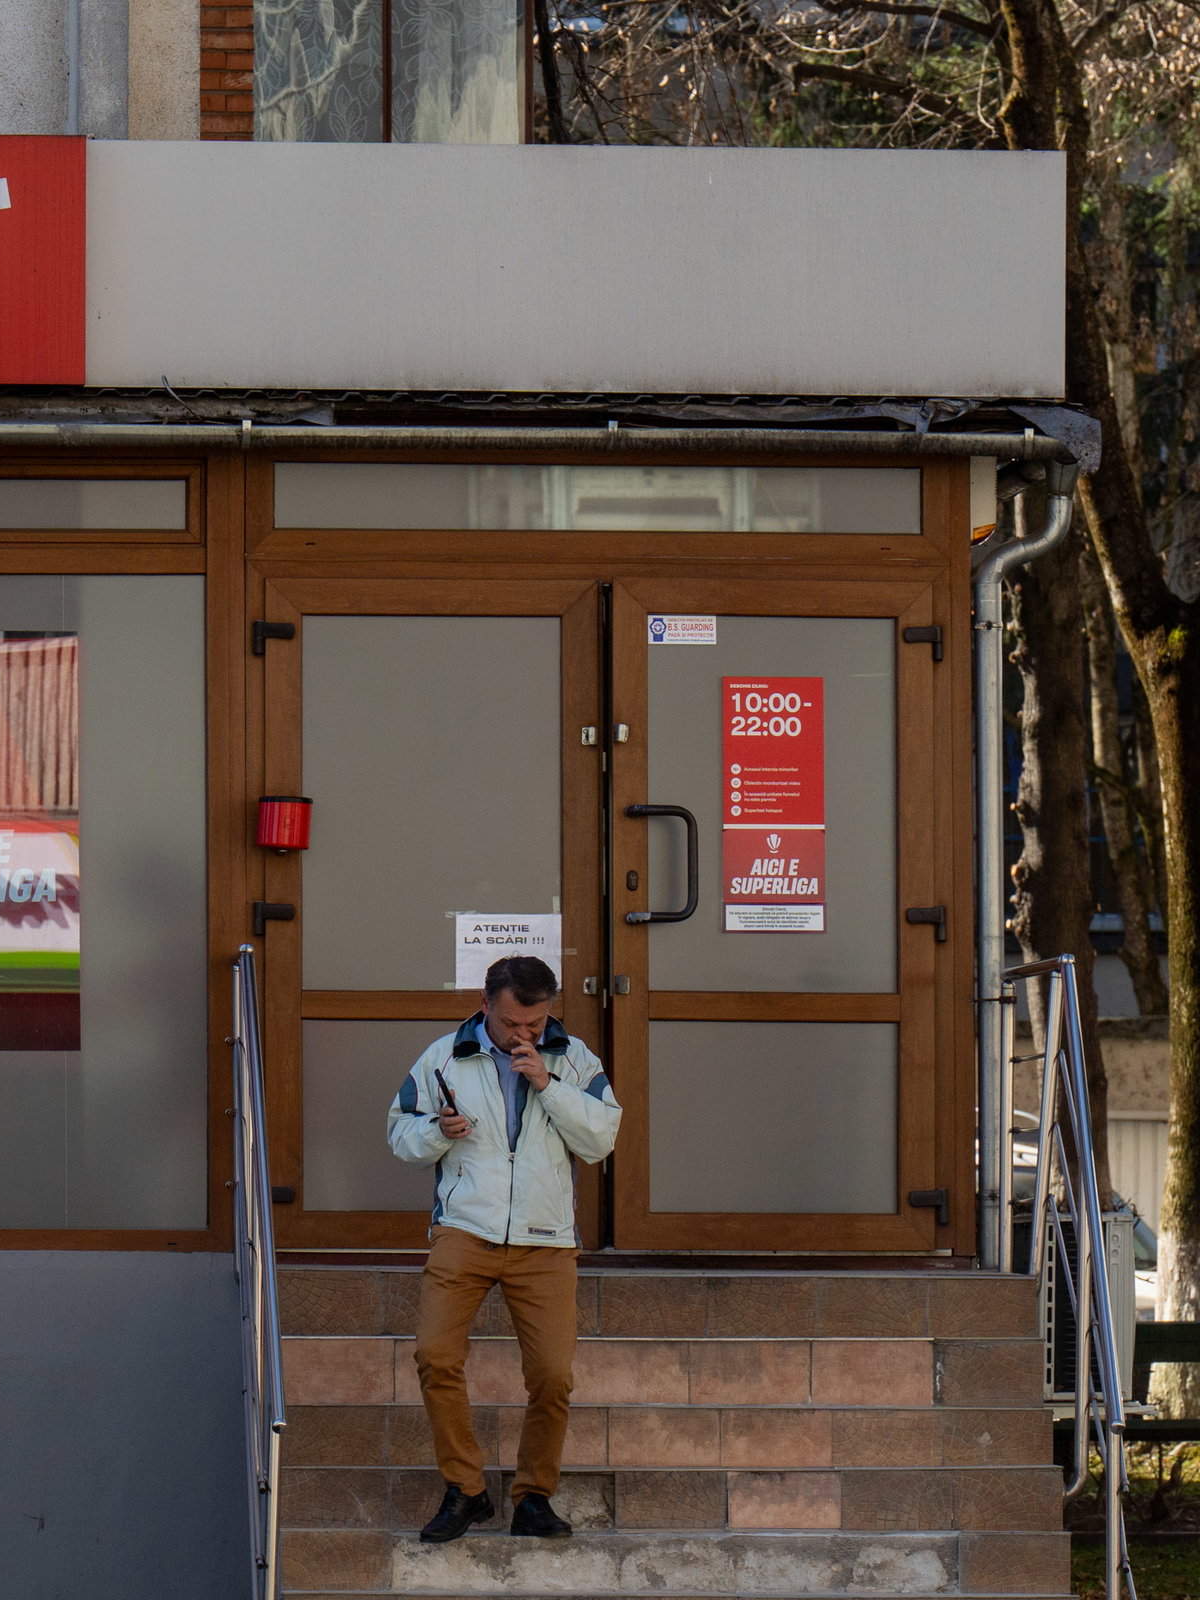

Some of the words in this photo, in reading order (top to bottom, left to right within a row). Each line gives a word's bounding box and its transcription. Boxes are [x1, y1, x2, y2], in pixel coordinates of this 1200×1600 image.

[667, 623, 680, 631] B.S.
[681, 623, 714, 631] GUARDING
[731, 716, 802, 736] 22:00
[750, 858, 785, 875] AICI
[788, 858, 800, 875] E
[730, 877, 818, 895] SUPERLIGA
[486, 935, 527, 944] SCĂRI
